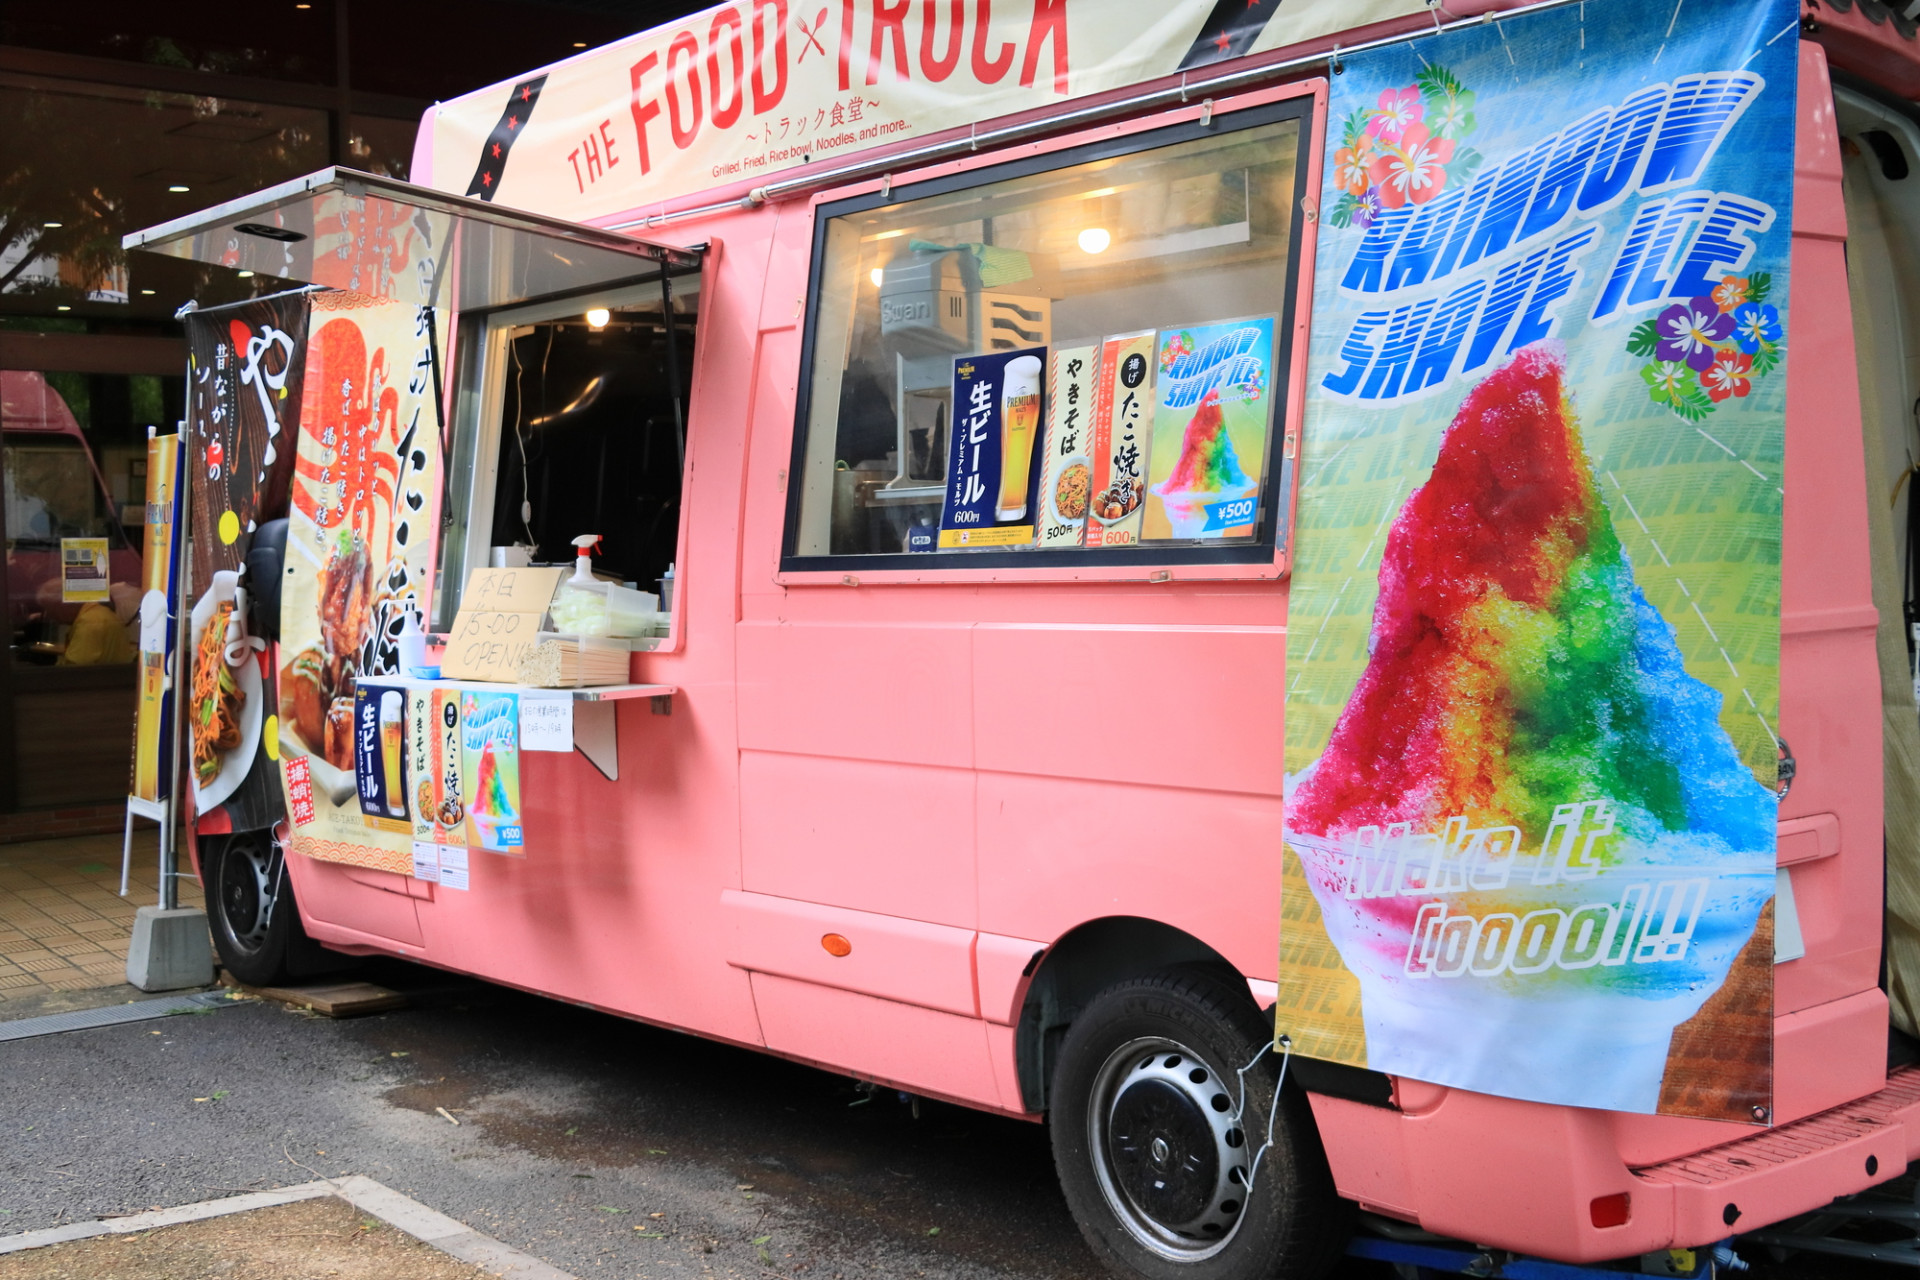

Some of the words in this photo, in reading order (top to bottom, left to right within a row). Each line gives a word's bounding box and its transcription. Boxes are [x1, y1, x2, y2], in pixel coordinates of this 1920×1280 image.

[567, 118, 619, 194] THE
[630, 0, 789, 176] FOOD
[769, 147, 788, 163] Rice
[790, 141, 814, 157] bowl,
[816, 132, 857, 152] Noodles,
[860, 127, 878, 140] and
[880, 118, 912, 136] more...
[1340, 71, 1765, 297] RAINBOW
[882, 300, 930, 324] Swan
[1320, 223, 1603, 407] SHAVE
[1589, 191, 1775, 325] ICE
[1128, 358, 1140, 383] 揚げ
[1168, 328, 1262, 379] RAINBOW
[1007, 393, 1036, 408] PREMIUM
[1163, 363, 1227, 409] SHAVE
[1226, 356, 1262, 387] ICE
[208, 343, 228, 481] 昔ながらの
[1060, 359, 1082, 455] やきそば
[962, 380, 992, 506] 生ビール
[1113, 391, 1140, 504] たこ焼き
[954, 511, 980, 523] 600円
[1047, 524, 1073, 539] 500円
[1218, 501, 1252, 520] ¥500
[1106, 531, 1136, 544] 600円
[478, 571, 517, 597] 本日
[463, 640, 531, 671] OPEN!
[416, 699, 425, 772] やきそば
[467, 697, 513, 729] RAINBOW
[496, 718, 513, 740] ICE
[362, 704, 378, 798] 生ビール
[444, 731, 460, 816] たこ焼き
[502, 828, 520, 839] ¥500
[1345, 815, 1522, 901] Make
